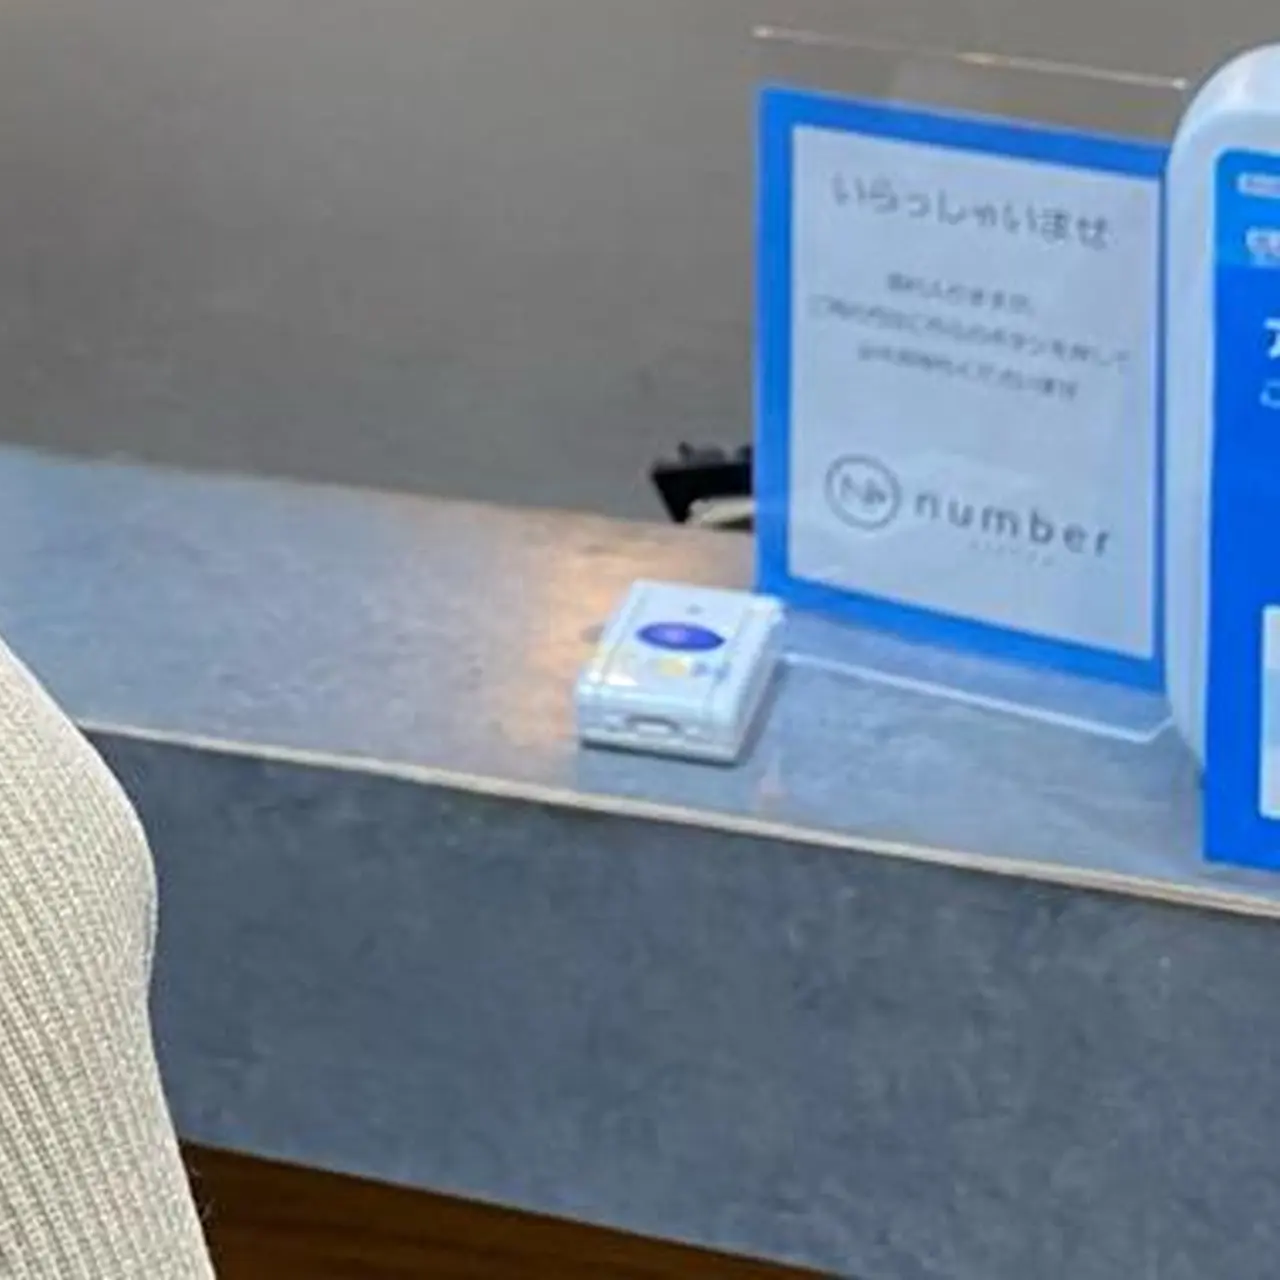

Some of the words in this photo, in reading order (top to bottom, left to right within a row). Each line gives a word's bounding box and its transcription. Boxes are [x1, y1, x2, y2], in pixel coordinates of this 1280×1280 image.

[831, 172, 1110, 251] いらっしゃいませ
[915, 488, 1111, 557] number
